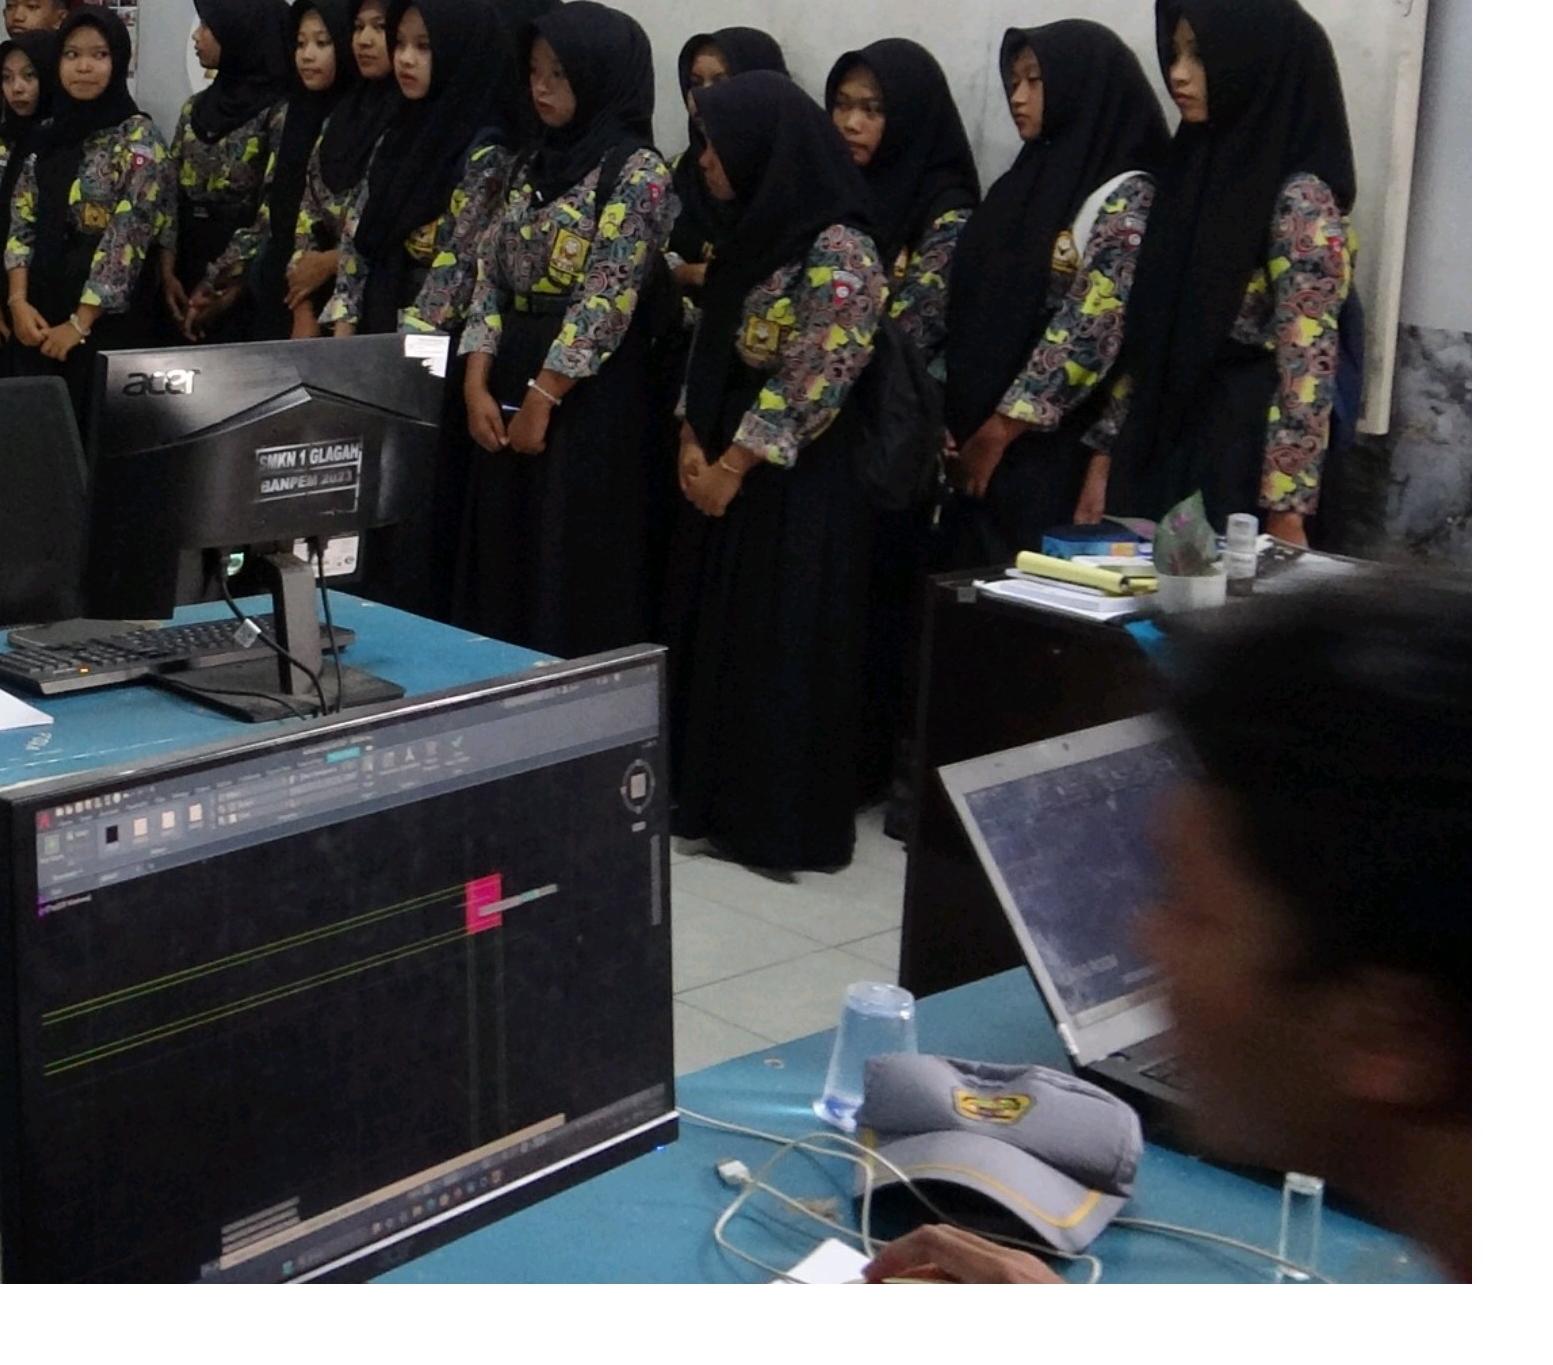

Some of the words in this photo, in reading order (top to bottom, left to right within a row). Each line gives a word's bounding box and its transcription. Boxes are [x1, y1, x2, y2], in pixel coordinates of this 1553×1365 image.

[122, 368, 201, 397] acer
[259, 450, 297, 470] SMKN
[298, 448, 307, 467] 1
[309, 442, 360, 465] GLAGAH
